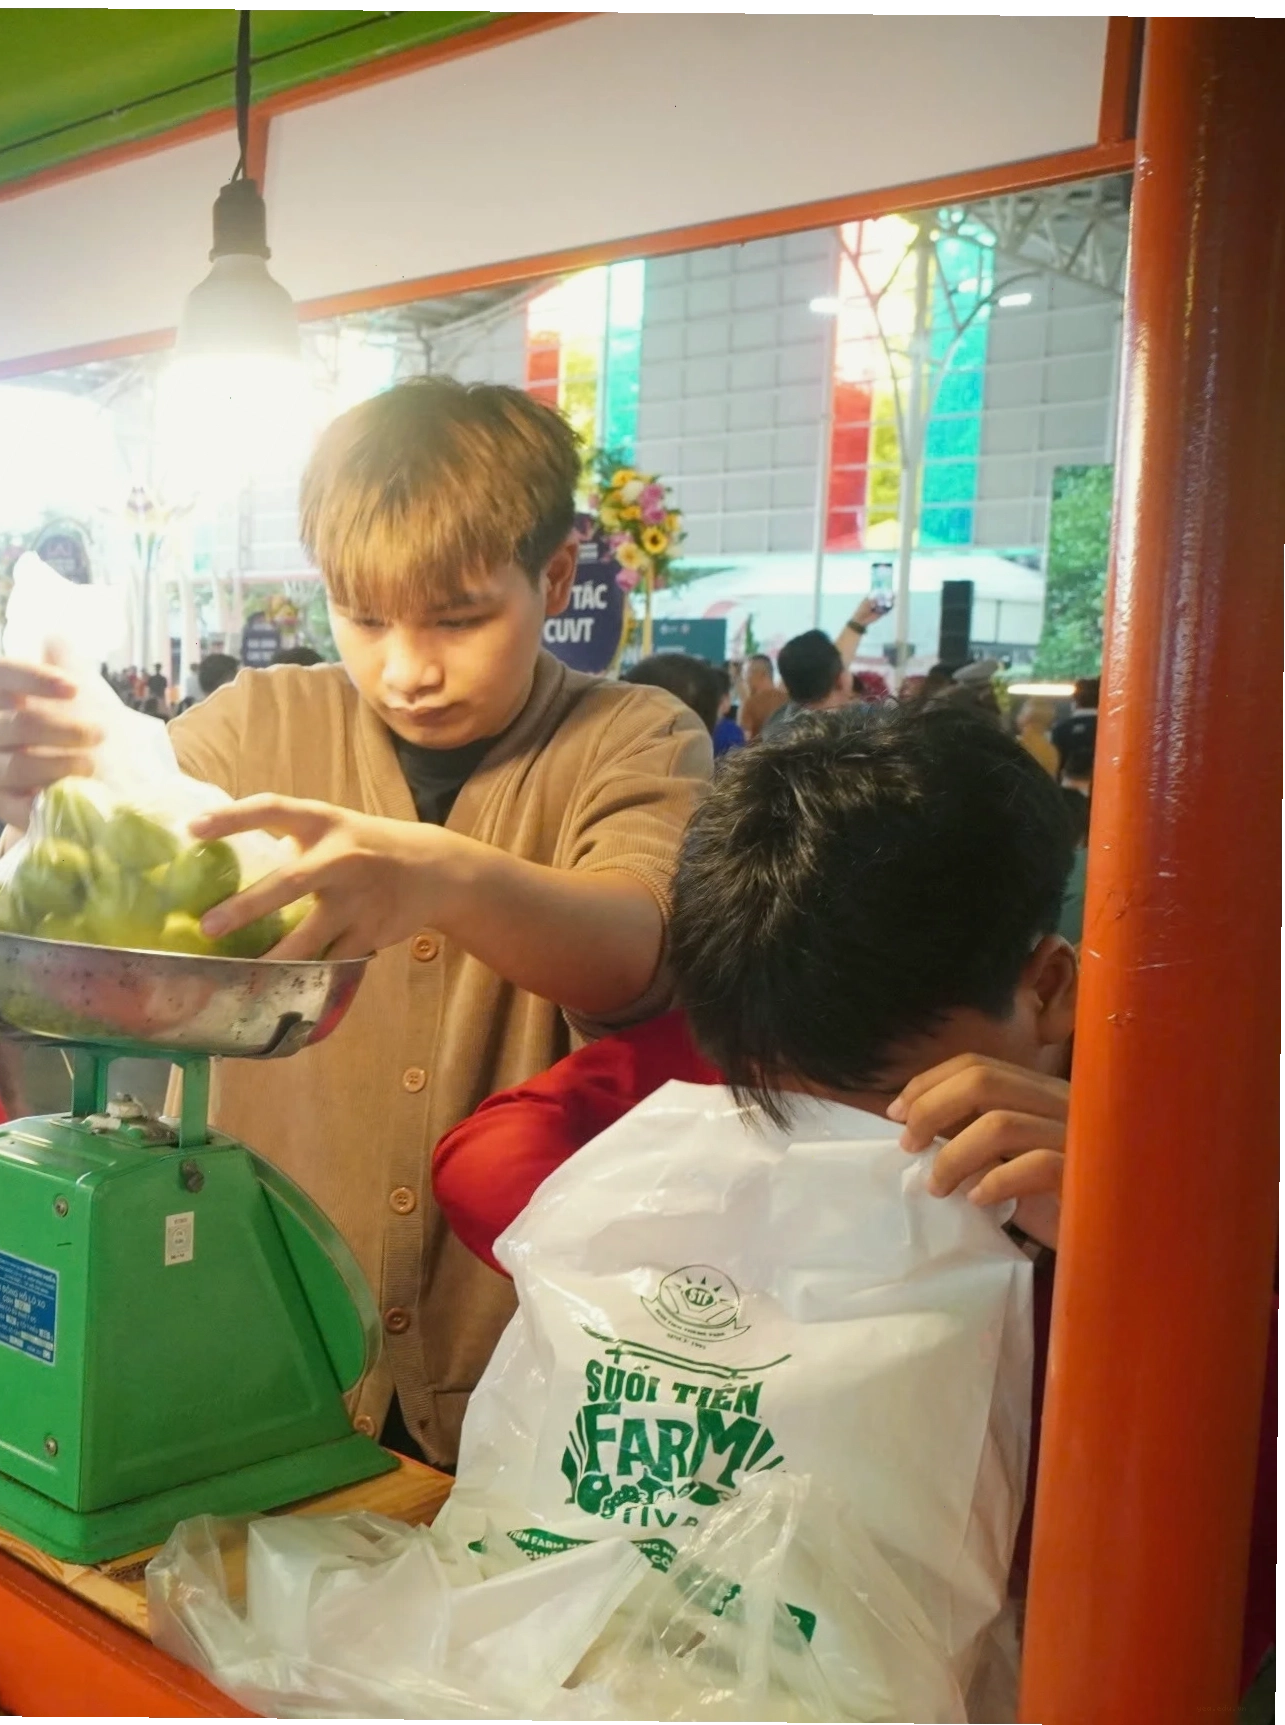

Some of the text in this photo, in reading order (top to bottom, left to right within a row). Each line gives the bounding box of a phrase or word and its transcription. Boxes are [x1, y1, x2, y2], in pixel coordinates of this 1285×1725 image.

[571, 580, 608, 610] TÁC
[687, 1288, 711, 1306] STF
[585, 1358, 660, 1402] SUỐI
[582, 1401, 762, 1490] FARM
[530, 1535, 564, 1549] FARM
